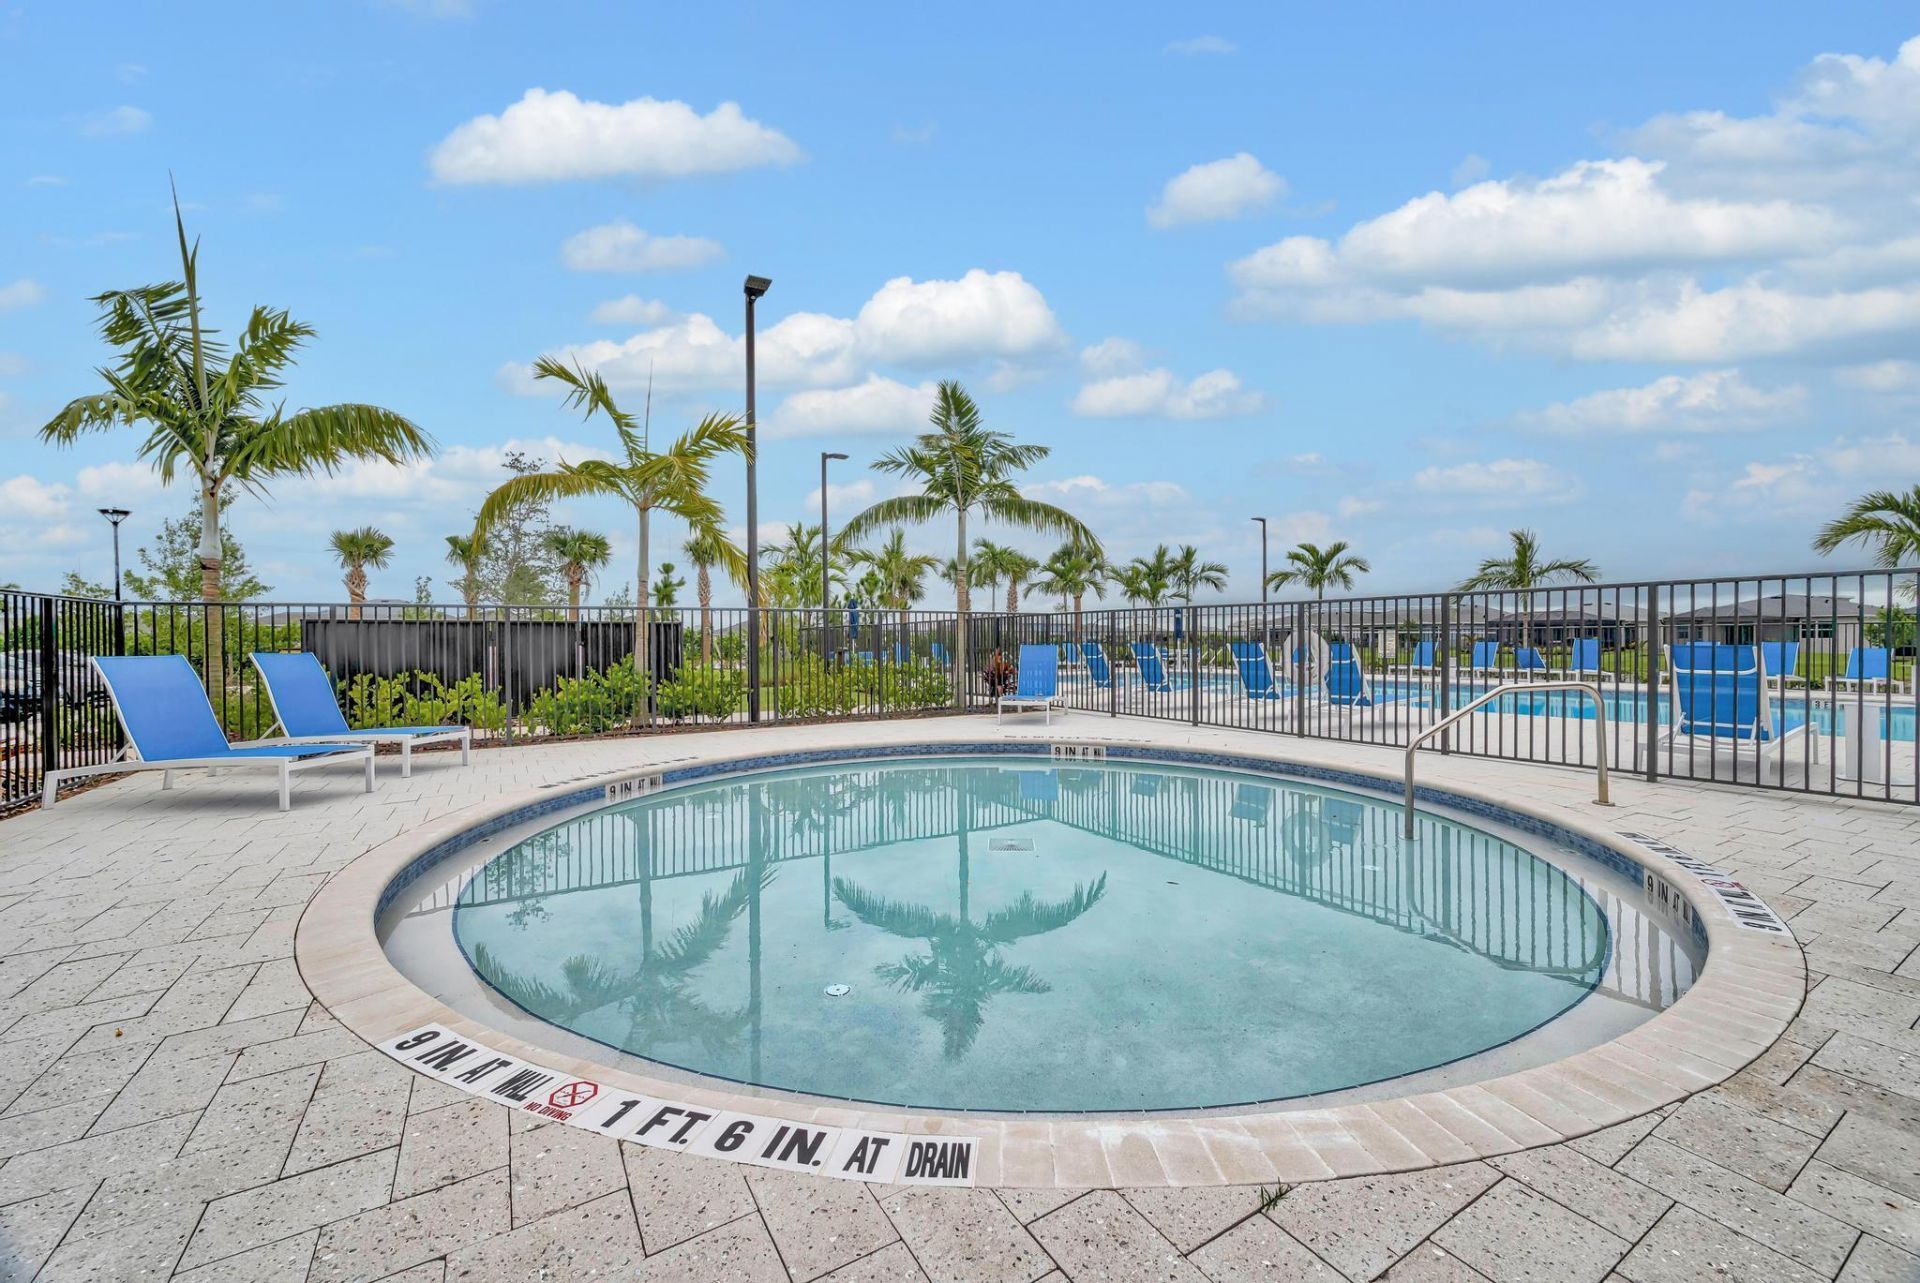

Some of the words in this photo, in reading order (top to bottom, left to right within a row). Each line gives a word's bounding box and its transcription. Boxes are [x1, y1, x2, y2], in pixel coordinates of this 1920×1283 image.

[1054, 746, 1061, 756] 9
[1065, 746, 1076, 757] IN
[609, 785, 616, 795] 9
[620, 781, 632, 793] IN
[1647, 874, 1653, 893] 9
[1657, 880, 1668, 904] IN
[395, 1030, 441, 1051] 9
[414, 1040, 477, 1072] IN.
[453, 1057, 513, 1085] AT
[490, 1068, 554, 1102] WALL
[523, 1101, 542, 1112] NO
[537, 1105, 573, 1121] DIVING
[600, 1100, 641, 1128] 1
[635, 1106, 711, 1145] FT.
[713, 1120, 754, 1152] 6
[760, 1126, 827, 1167] IN.
[842, 1136, 890, 1174] AT
[905, 1142, 972, 1180] DRAIN
